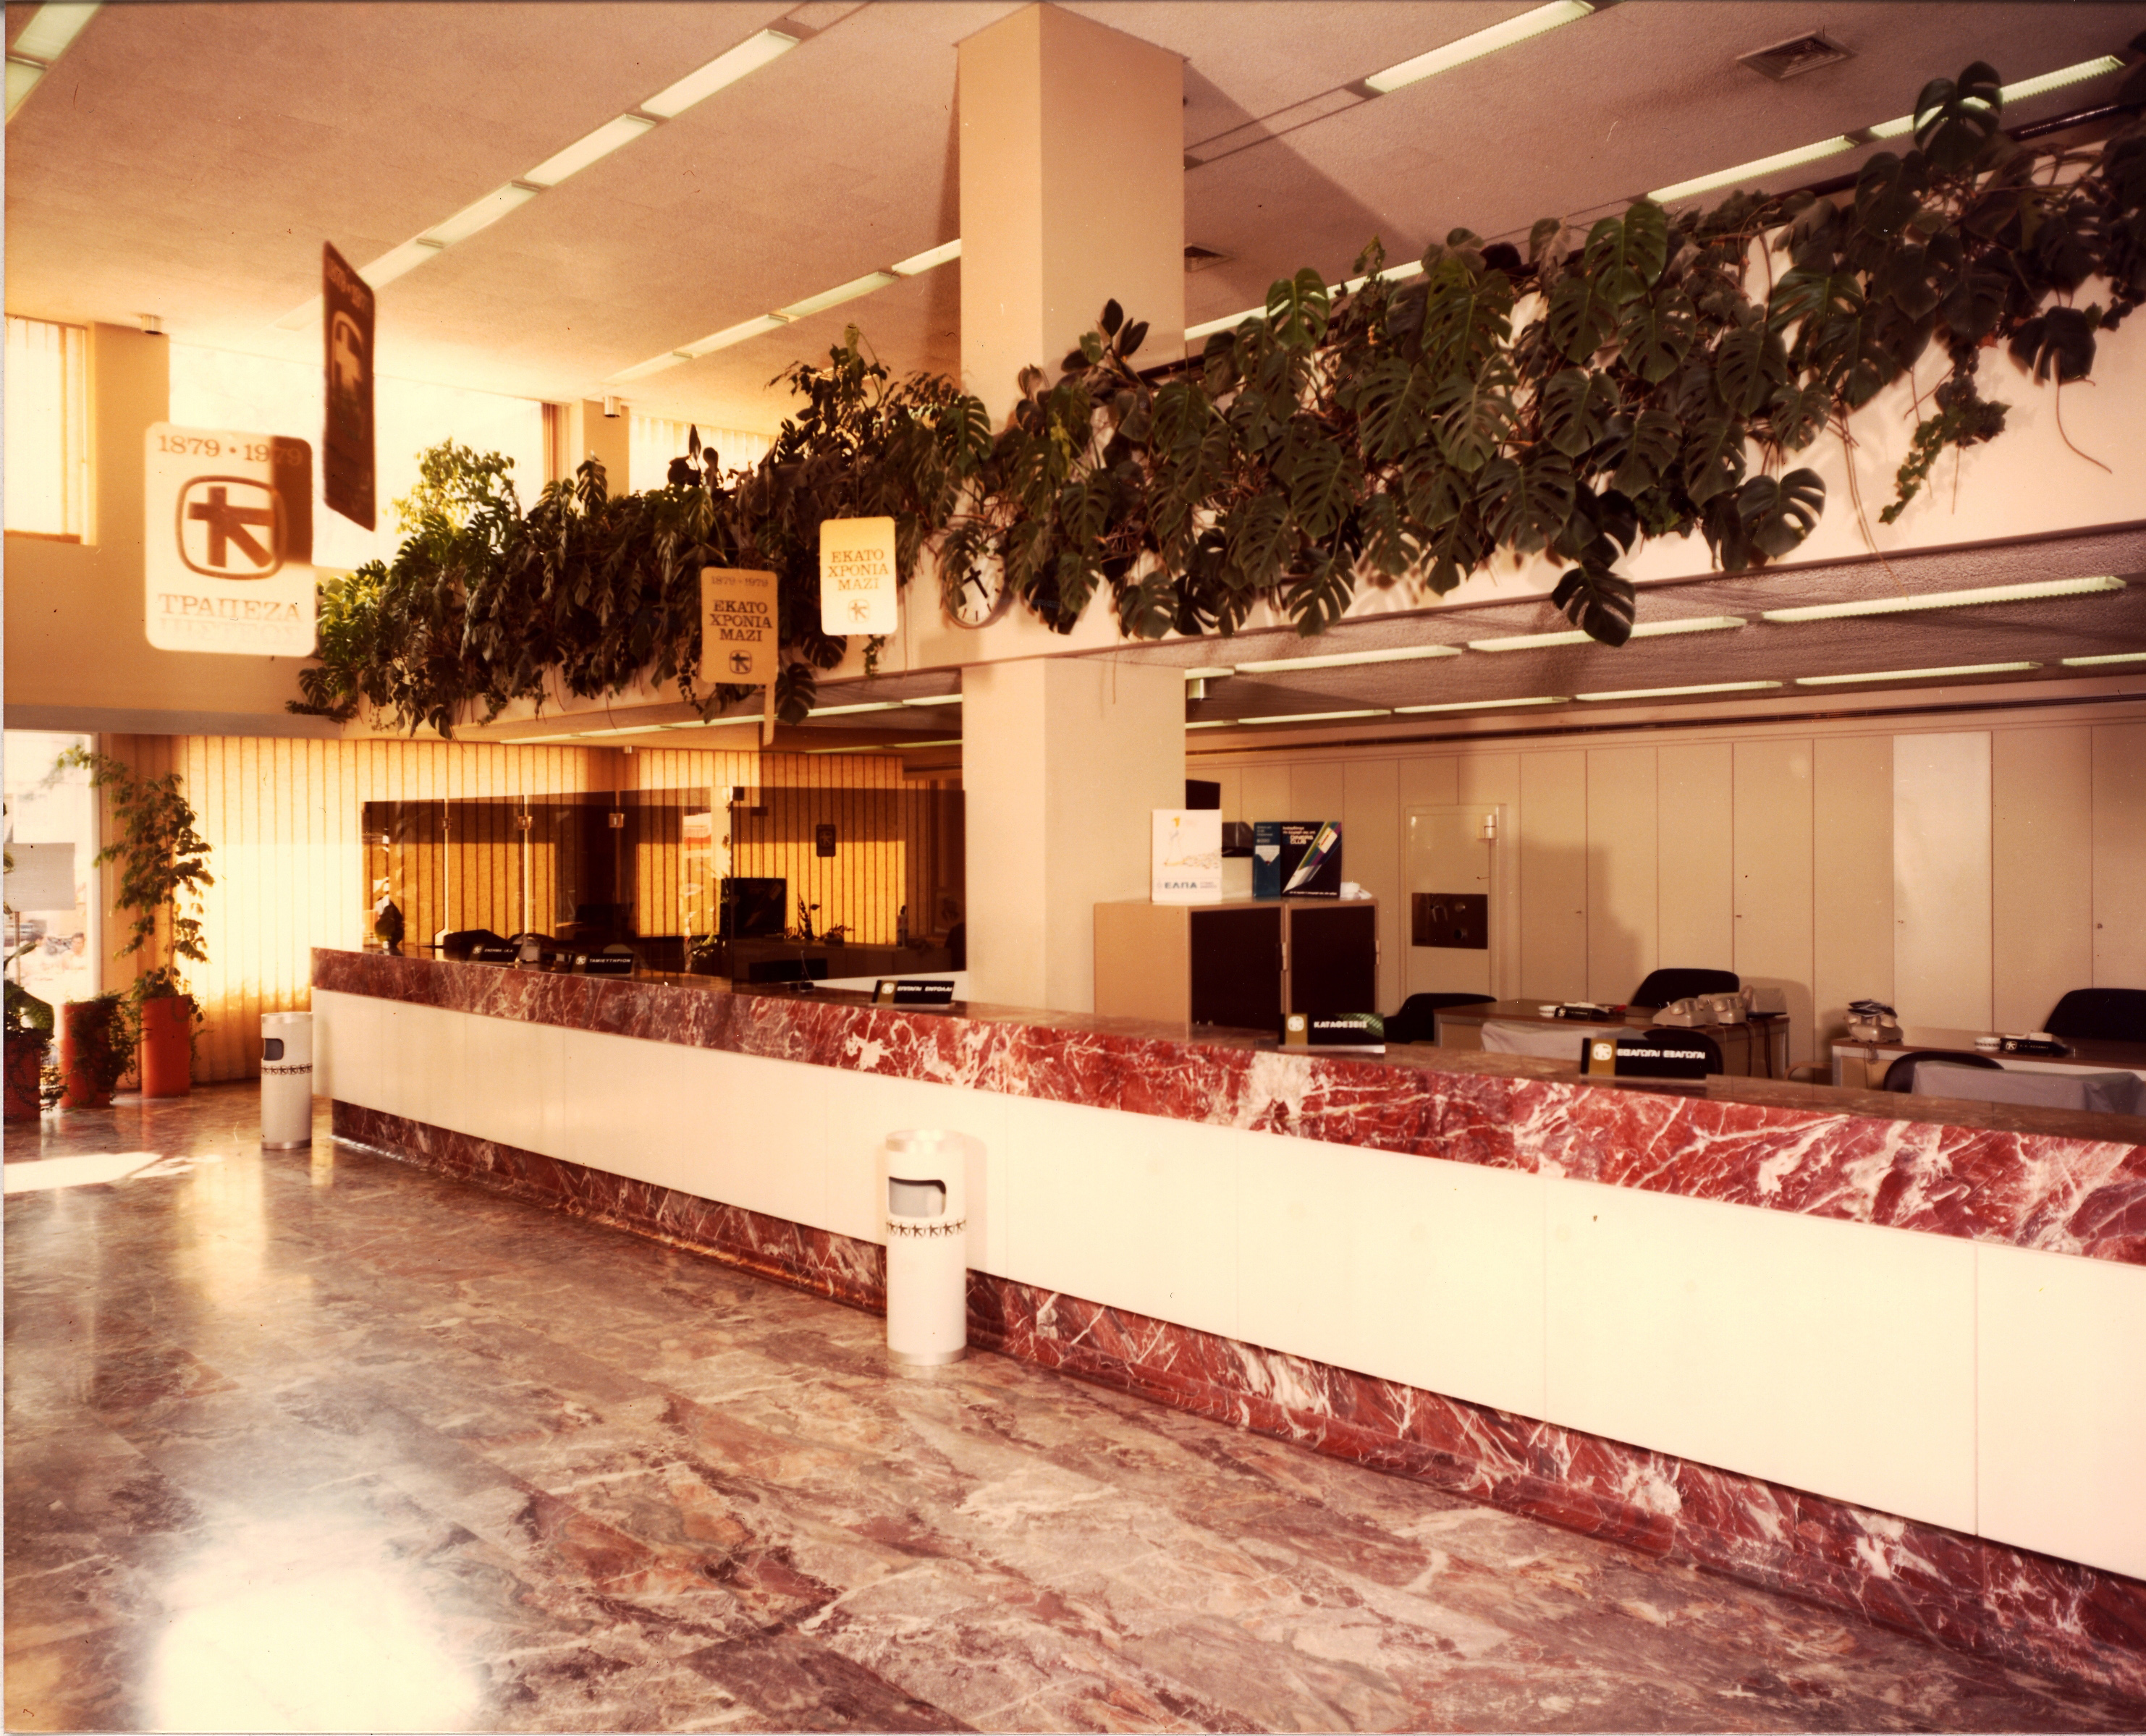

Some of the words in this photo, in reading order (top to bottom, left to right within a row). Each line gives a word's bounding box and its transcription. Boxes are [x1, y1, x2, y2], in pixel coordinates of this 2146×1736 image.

[158, 435, 221, 457] 1879
[243, 444, 304, 467] 1979
[831, 548, 884, 563] ΕΚΑΤΟ
[827, 563, 889, 578] ΧΡΟΝΙΑ
[837, 577, 879, 591] ΜΑΖΙ
[157, 593, 301, 622] ΤΡΑΠΕΖΑ
[713, 599, 768, 614] ΕΚΑΤΟ
[709, 614, 773, 629] ΧΡΟΝΙΑ
[719, 627, 763, 642] ΜΑΖΙ
